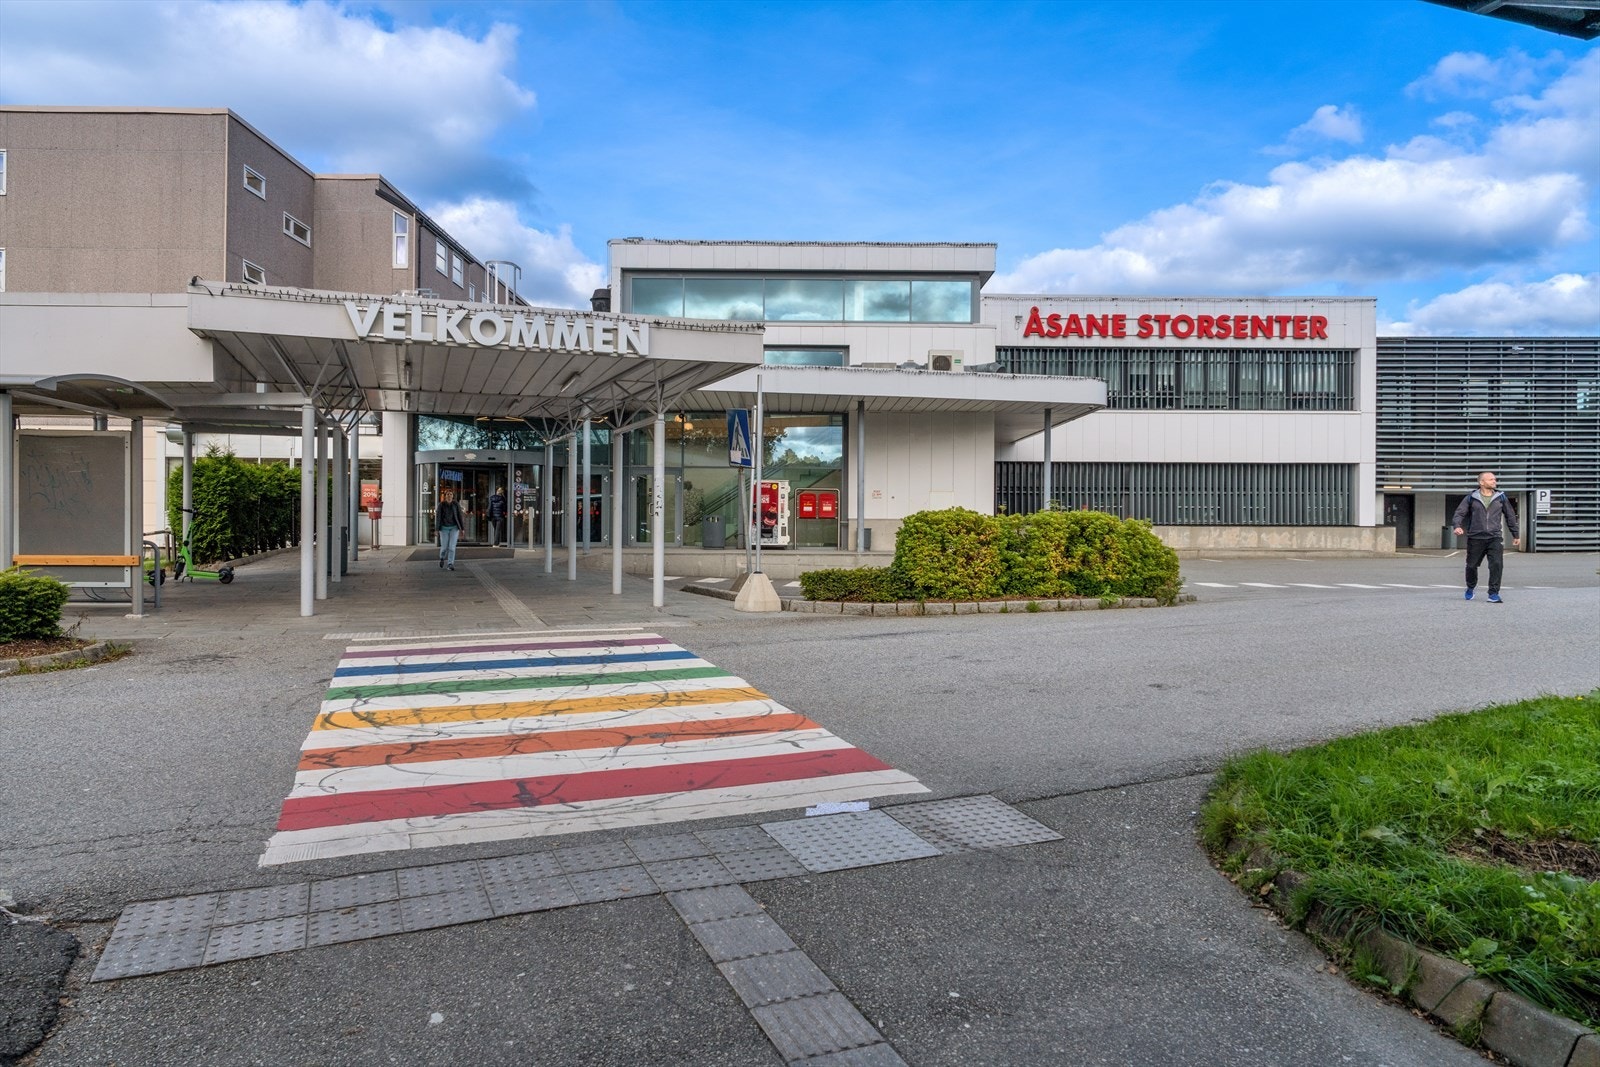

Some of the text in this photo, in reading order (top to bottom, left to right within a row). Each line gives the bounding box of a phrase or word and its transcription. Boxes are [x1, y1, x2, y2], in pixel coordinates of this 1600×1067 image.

[343, 300, 650, 357] VELKOMMEN
[1023, 306, 1328, 340] ÅSANE STORSENTER
[1540, 490, 1548, 502] P
